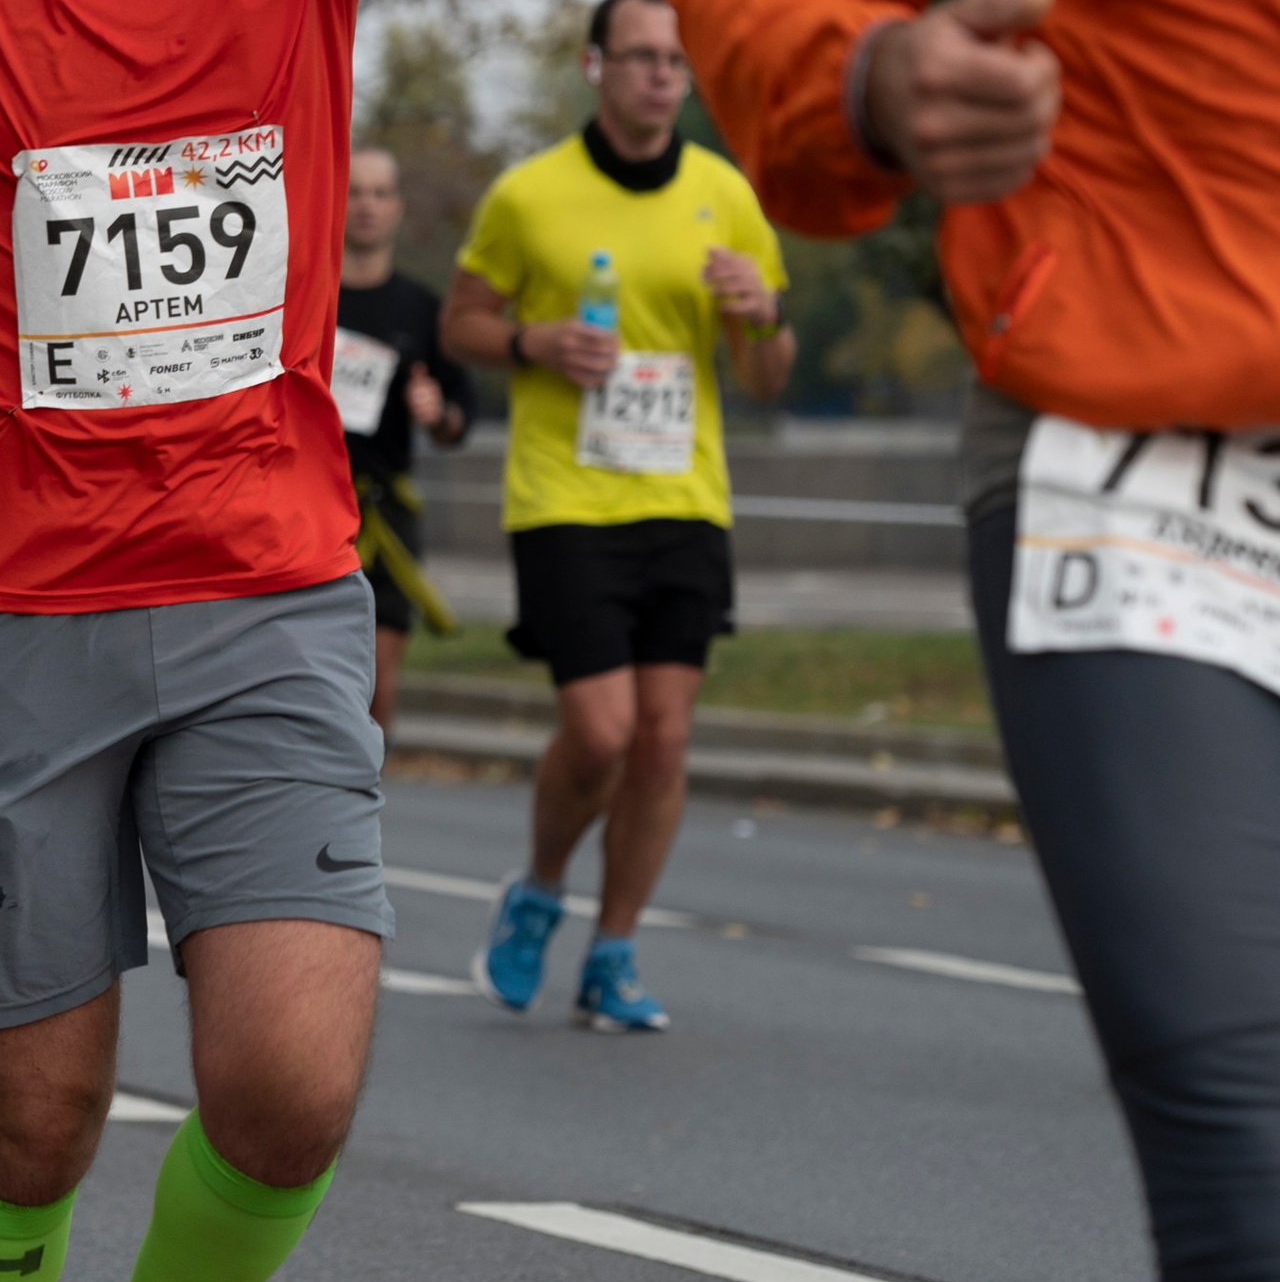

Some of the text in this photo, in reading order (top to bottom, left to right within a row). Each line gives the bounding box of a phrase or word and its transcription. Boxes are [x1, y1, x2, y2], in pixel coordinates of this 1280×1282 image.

[181, 138, 232, 162] 42,2
[46, 201, 256, 297] 7159
[115, 294, 203, 324] АРТЕМ
[232, 328, 265, 342] СИБУР
[47, 342, 76, 385] E
[150, 362, 192, 375] FONBET
[1051, 549, 1100, 610] D
